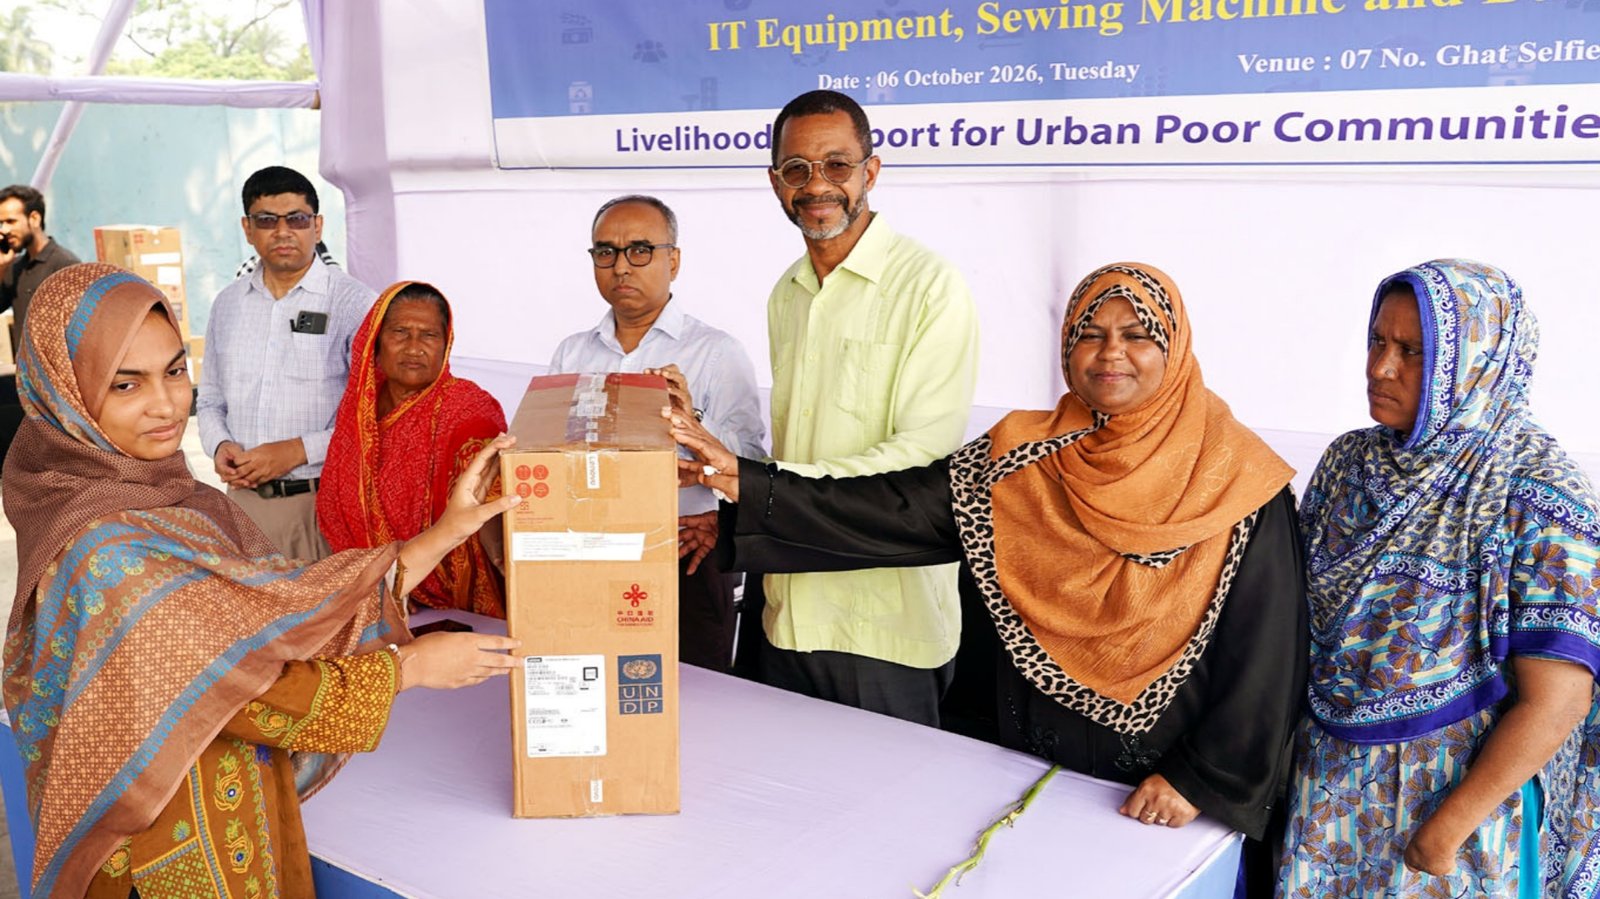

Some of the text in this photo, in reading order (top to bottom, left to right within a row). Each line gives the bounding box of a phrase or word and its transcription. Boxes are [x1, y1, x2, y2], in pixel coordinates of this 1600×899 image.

[708, 20, 747, 51] IT
[756, 9, 964, 55] Equipment,
[977, 0, 1124, 36] Sewing
[817, 74, 860, 90] Date
[876, 71, 899, 88] 06
[903, 68, 985, 87] October
[989, 64, 1044, 84] 2026,
[1049, 61, 1141, 83] Tuesday
[1237, 54, 1316, 74] Venue
[1340, 49, 1373, 70] 07
[1379, 48, 1427, 69] No.
[1435, 44, 1510, 66] Ghat
[1517, 39, 1600, 64] Selfie
[616, 124, 772, 152] Livelihood
[950, 118, 1005, 147] for
[1016, 116, 1141, 146] Urban
[1155, 114, 1261, 144] Poor
[1273, 104, 1600, 143] Communitie
